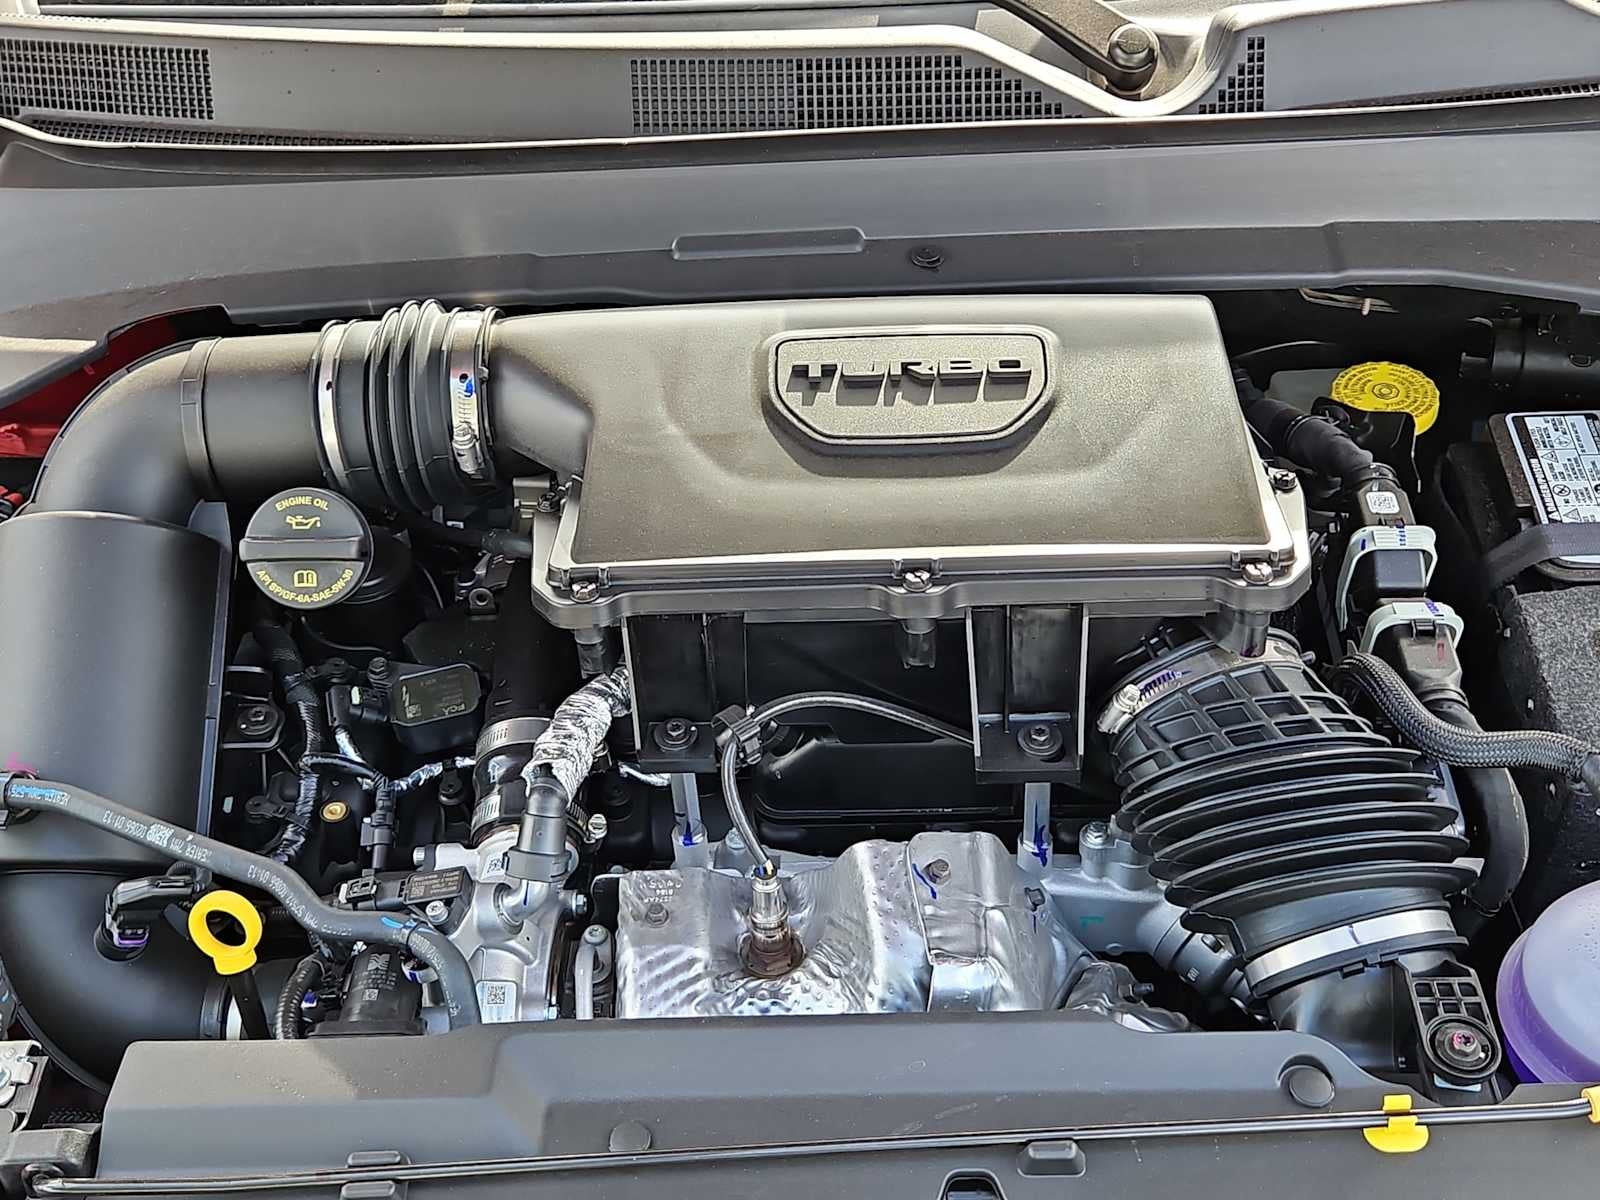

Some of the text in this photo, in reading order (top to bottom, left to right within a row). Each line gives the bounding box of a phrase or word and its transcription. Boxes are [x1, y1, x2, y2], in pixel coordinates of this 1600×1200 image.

[788, 359, 1033, 398] TURBO
[275, 496, 329, 511] ENGINE OIL
[256, 570, 272, 586] API
